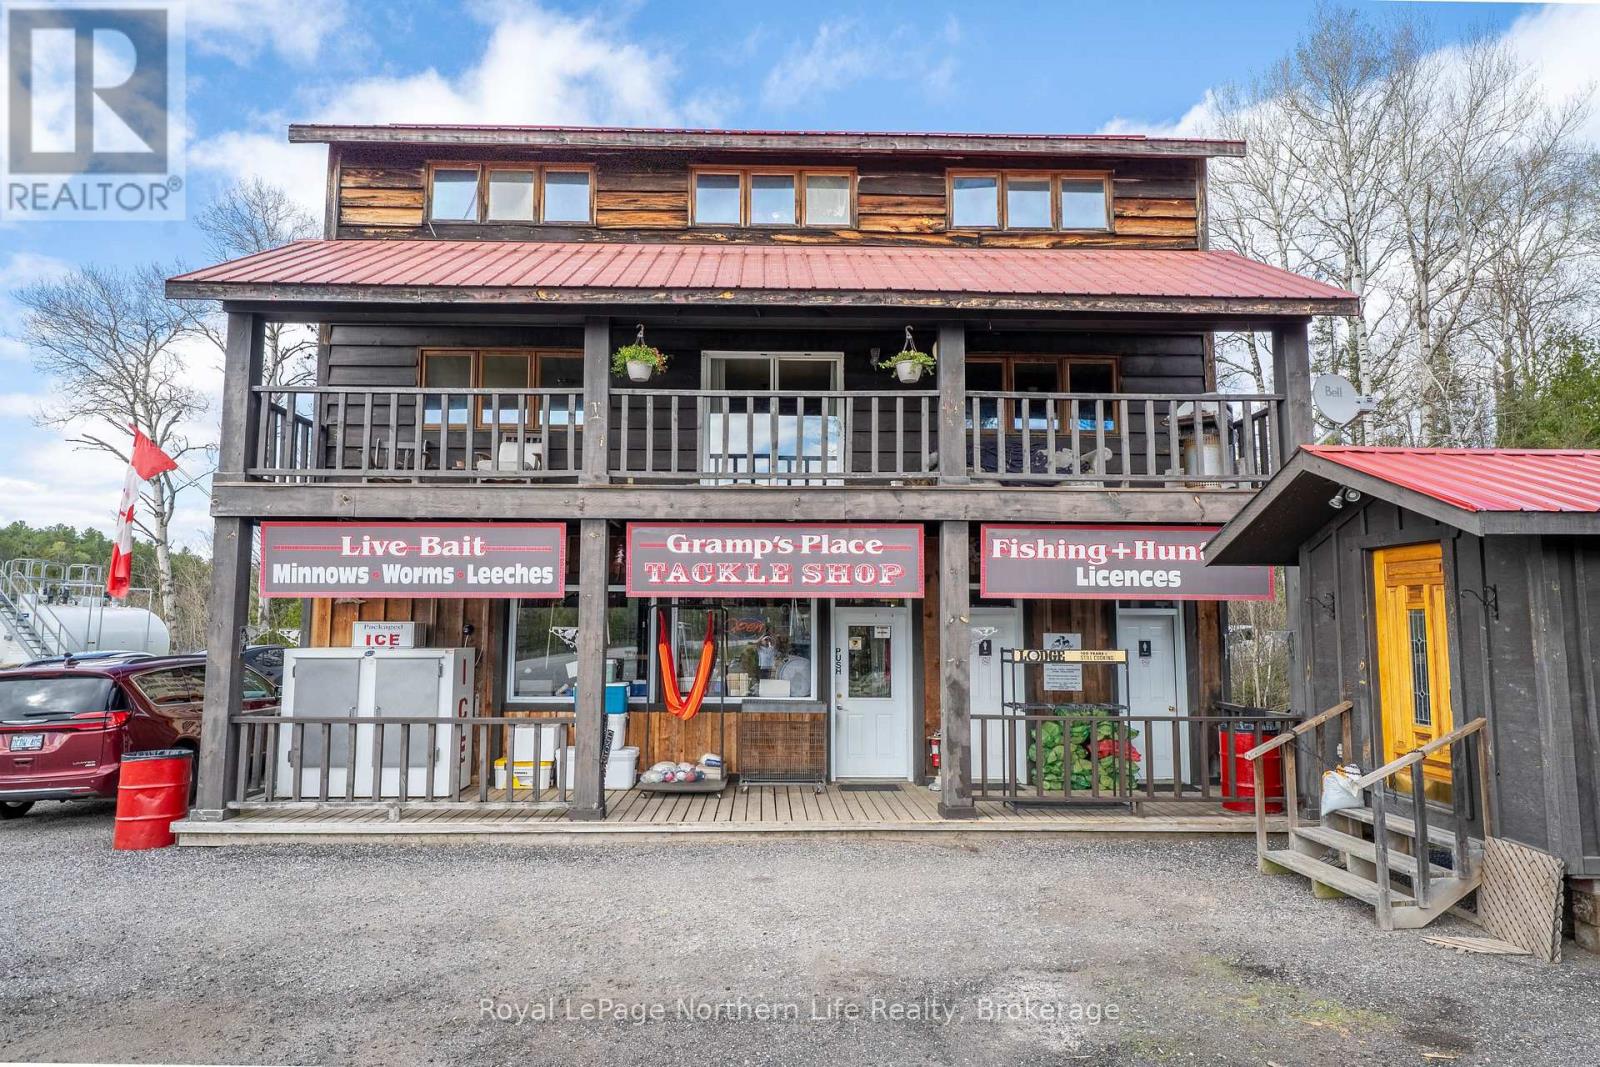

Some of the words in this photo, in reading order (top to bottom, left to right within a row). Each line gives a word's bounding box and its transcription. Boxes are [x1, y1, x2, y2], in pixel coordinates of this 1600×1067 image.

[1325, 385, 1342, 397] Bell
[340, 535, 408, 556] Live
[420, 535, 487, 556] Bait
[666, 534, 795, 560] Gramp's
[800, 534, 884, 555] Place
[272, 563, 370, 584] Minnows
[381, 563, 455, 584] Worms
[467, 563, 554, 584] Leeches
[644, 562, 793, 586] TACKLE
[801, 563, 905, 586] SHOP
[1076, 566, 1182, 588] Licences
[363, 623, 404, 632] Packaged
[365, 633, 401, 646] ICE
[1019, 650, 1066, 662] LODGE
